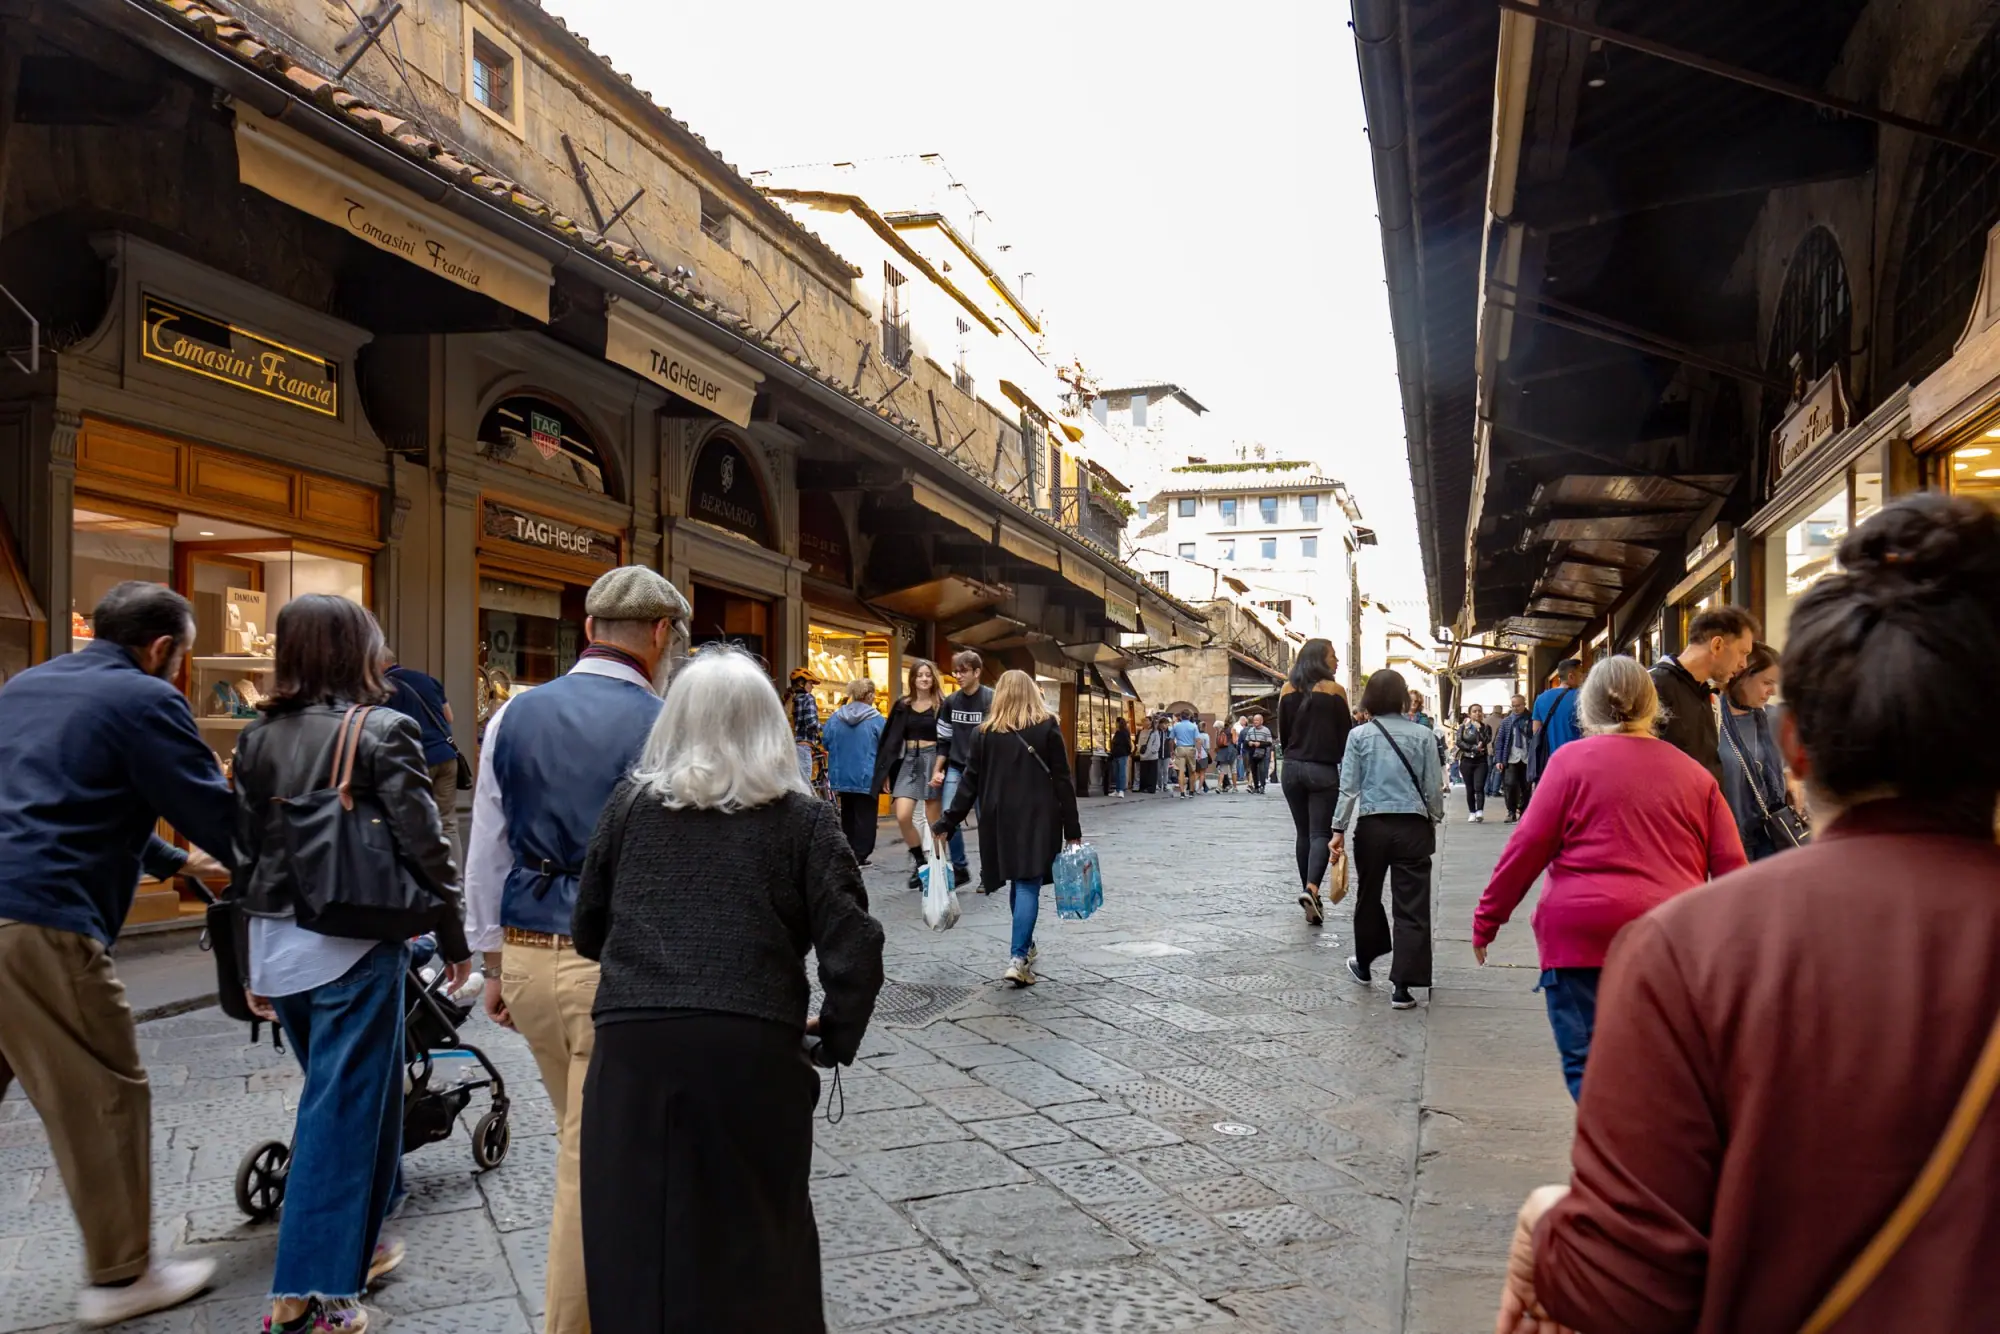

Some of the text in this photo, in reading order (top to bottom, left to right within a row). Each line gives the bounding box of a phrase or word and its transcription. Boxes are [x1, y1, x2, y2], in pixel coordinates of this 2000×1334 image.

[344, 197, 480, 286] Tomasini Francia
[150, 307, 332, 405] Tomasini Francia
[533, 416, 559, 436] TAG
[699, 491, 757, 528] BERNARDO
[234, 592, 260, 604] DAMIANI
